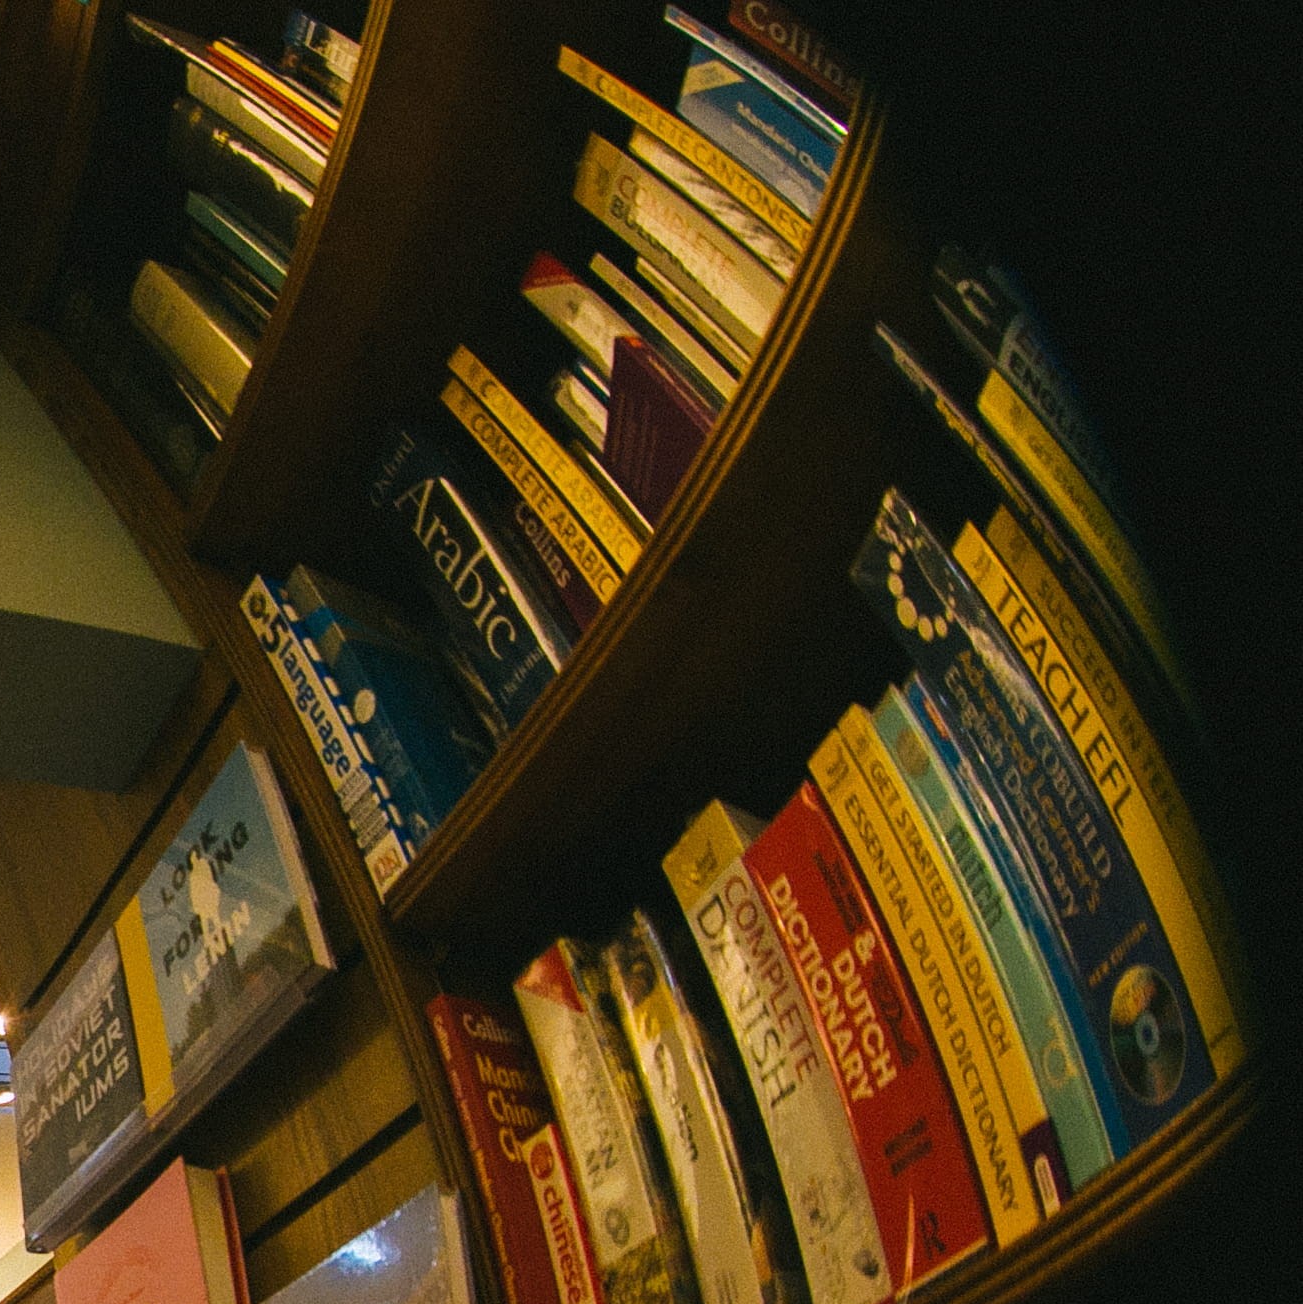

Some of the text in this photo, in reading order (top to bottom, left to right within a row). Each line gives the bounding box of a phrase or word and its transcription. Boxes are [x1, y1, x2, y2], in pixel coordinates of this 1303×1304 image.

[393, 478, 516, 661] Arabic
[470, 413, 616, 598] COMPLETE ARABIC
[514, 500, 571, 588] Collins
[567, 476, 635, 560] ARABIC
[278, 649, 351, 777] language
[993, 575, 1092, 735] TEACH
[1084, 732, 1131, 829] EFL
[1003, 765, 1080, 920] Dictionary
[723, 875, 821, 1085] COMPLETE
[768, 872, 874, 1104] DICTIONARY
[842, 796, 914, 932] ESSENTIAL
[909, 927, 957, 1030] DUTCH
[950, 1026, 1020, 1213] DICTIONARY
[895, 803, 954, 920] STARTED
[949, 919, 973, 958] IN
[965, 953, 1013, 1058] DUTCH
[22, 1016, 124, 1147] SANATOR
[45, 985, 116, 1088] SOVIET
[74, 1046, 130, 1122] IUMS
[832, 946, 898, 1091] DUTCH
